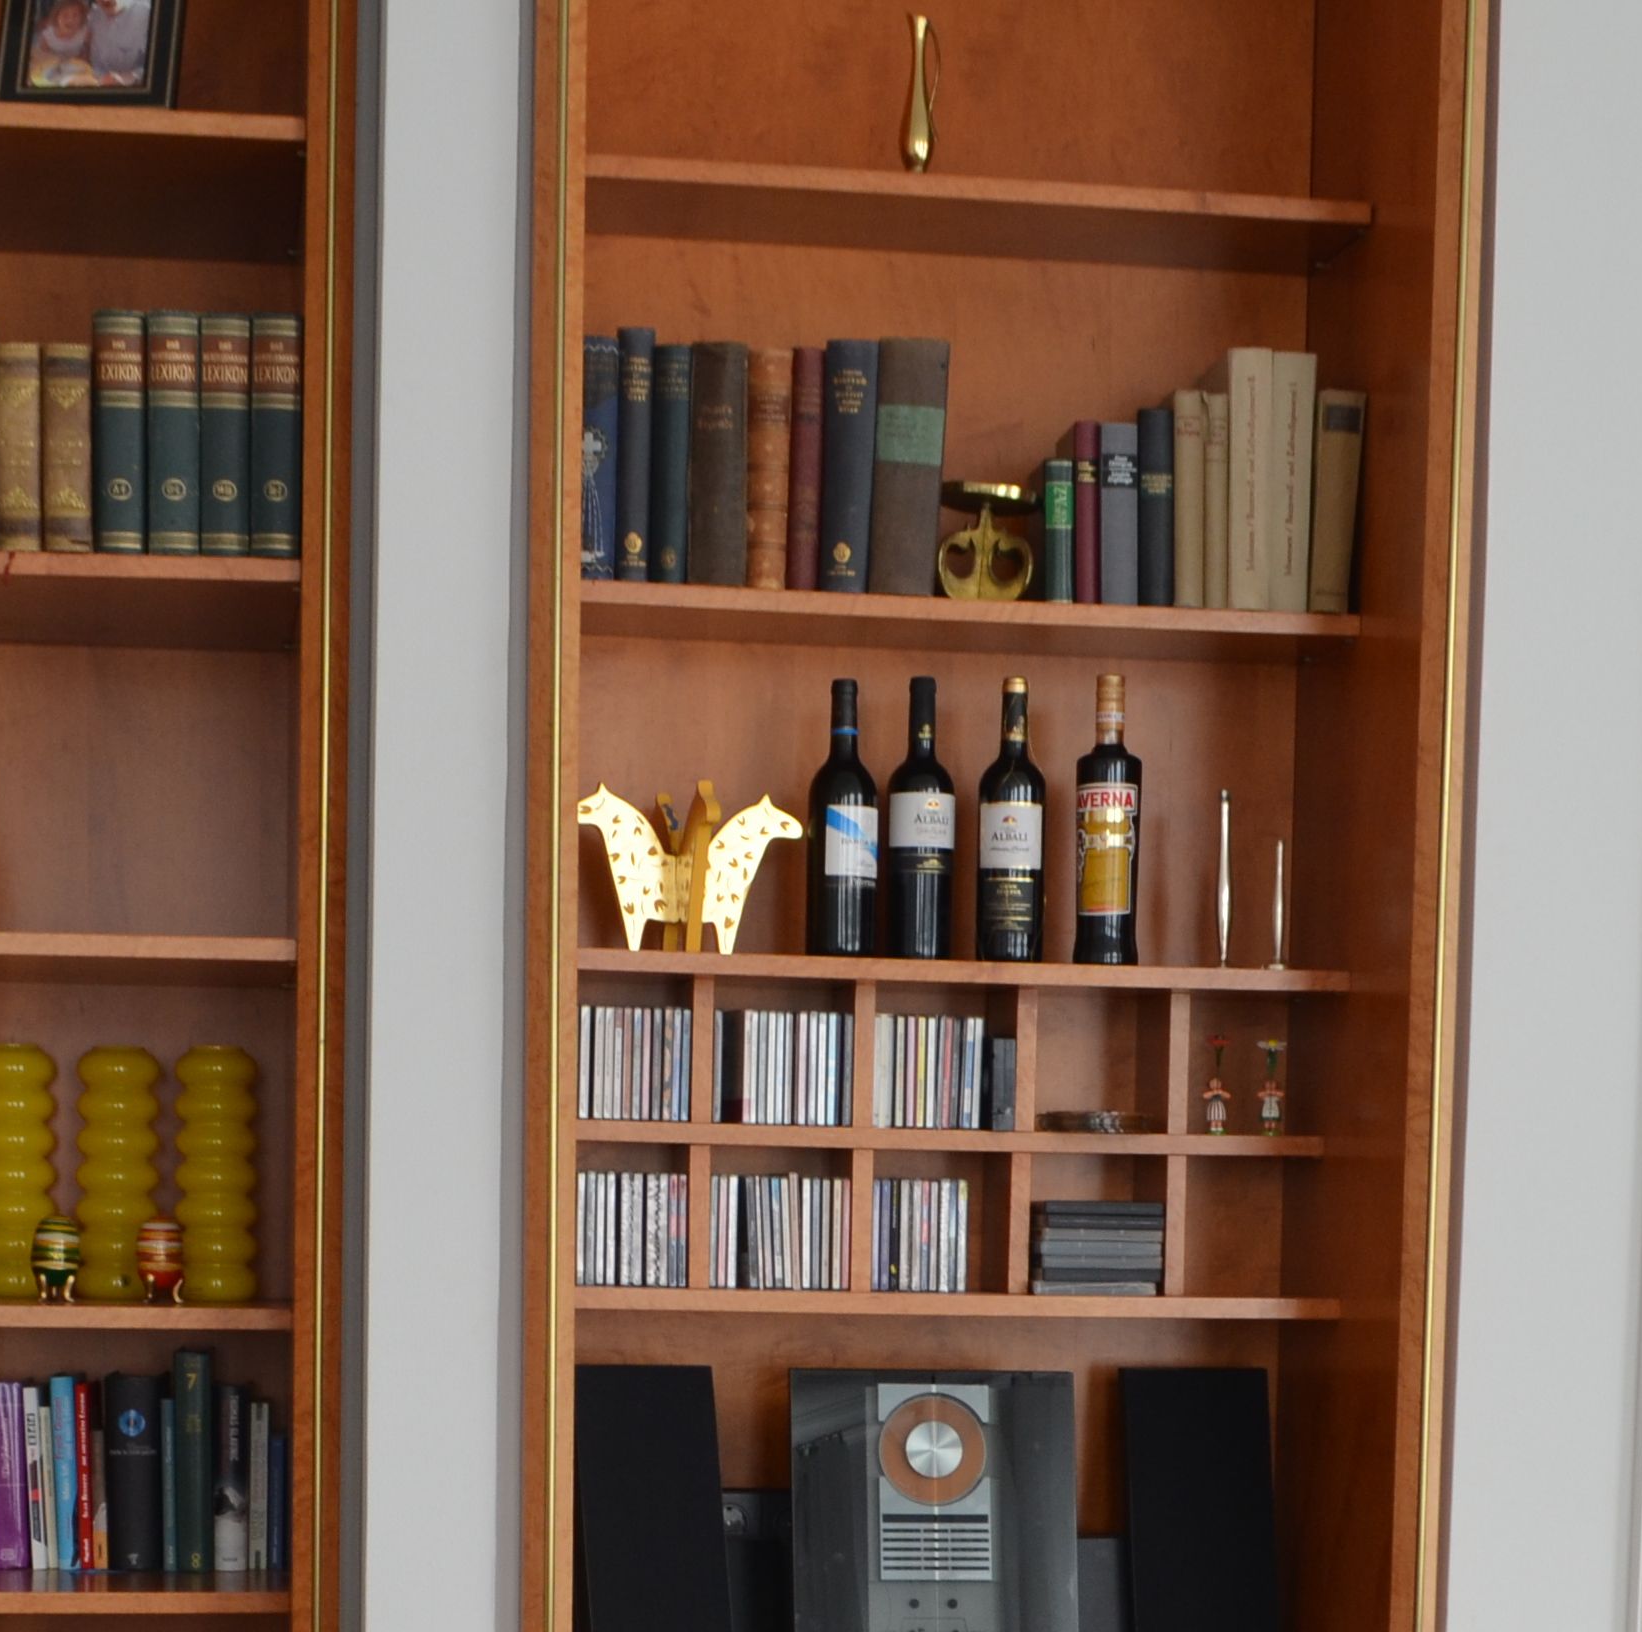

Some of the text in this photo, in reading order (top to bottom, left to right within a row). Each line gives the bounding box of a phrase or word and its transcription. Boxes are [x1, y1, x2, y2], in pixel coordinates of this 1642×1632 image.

[99, 364, 142, 381] LEXIKON
[150, 364, 195, 381] LEXIKON
[202, 365, 248, 383] LEXIKON
[253, 366, 299, 383] LEXIKON
[1077, 790, 1134, 809] AVERNA
[913, 813, 950, 826] ALBALI
[991, 830, 1029, 843] ALBALI
[186, 1373, 197, 1391] 7
[191, 1553, 201, 1569] 8
